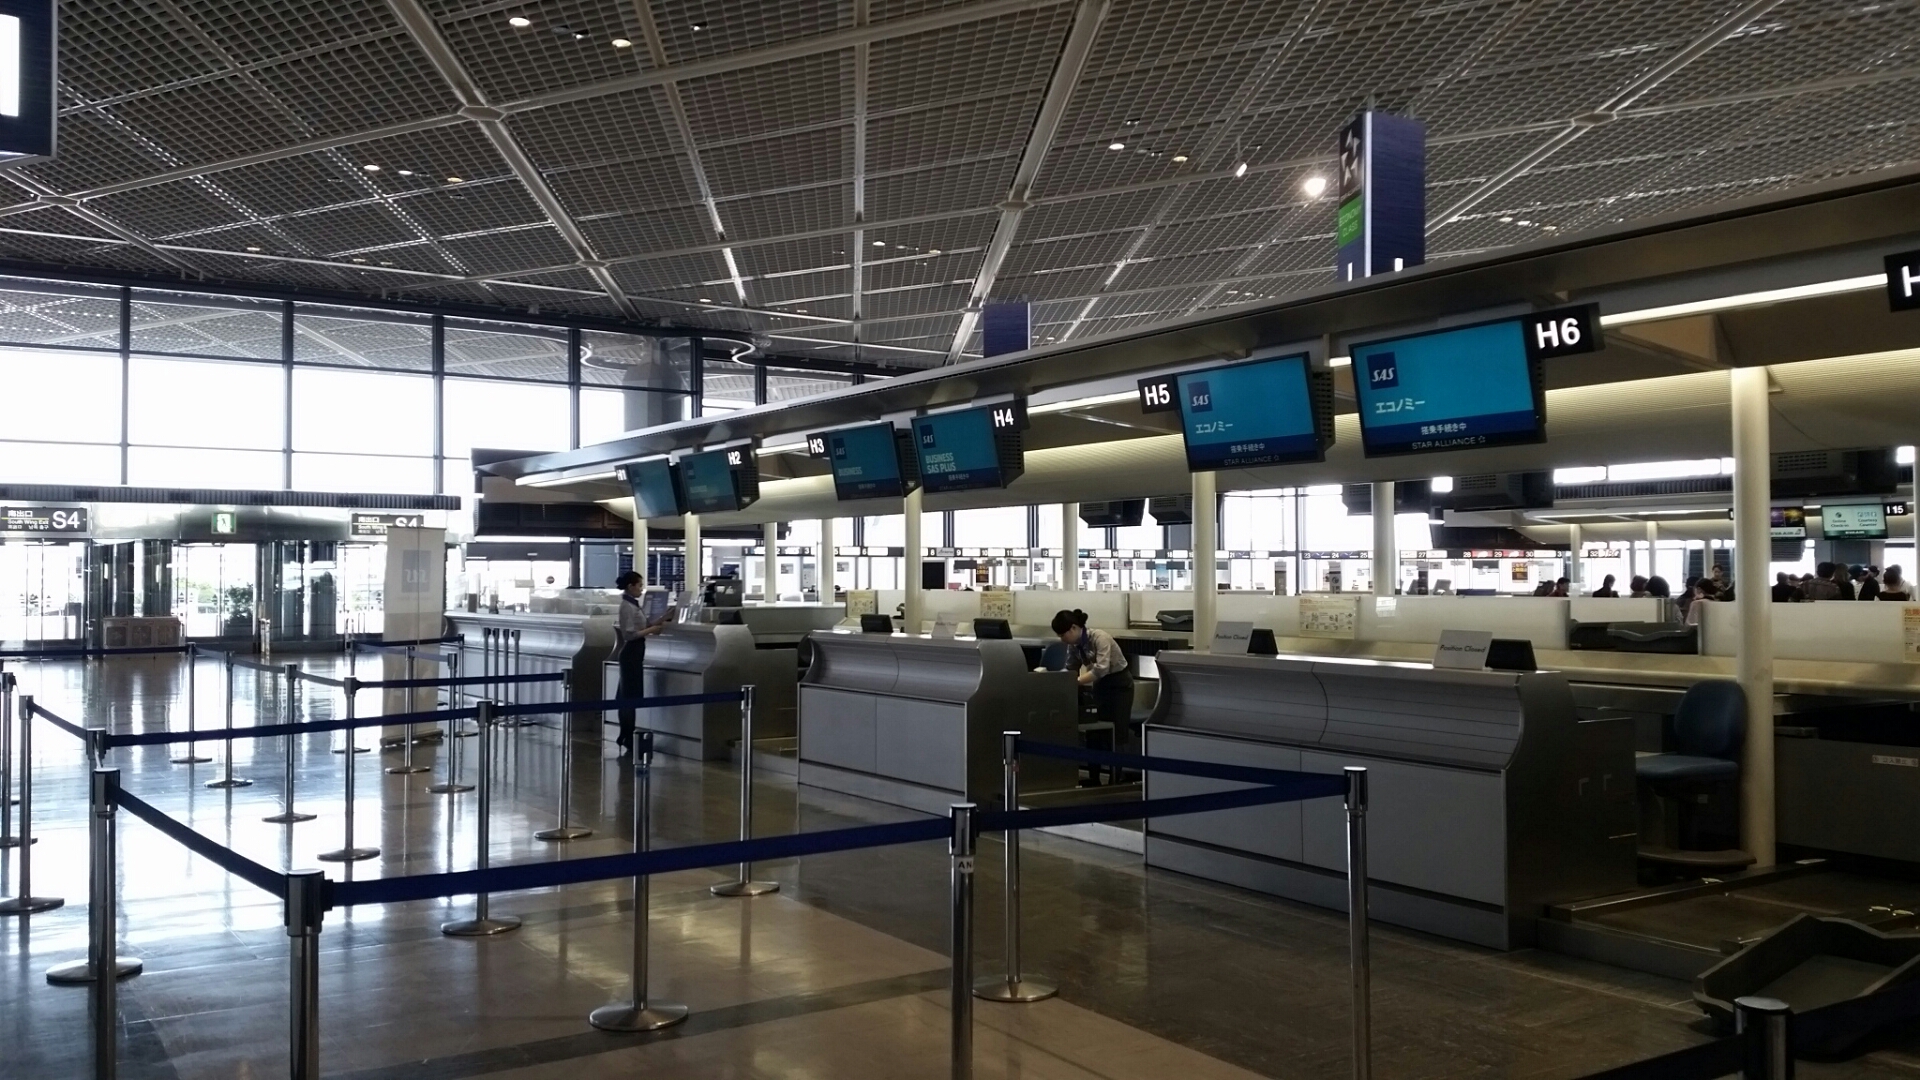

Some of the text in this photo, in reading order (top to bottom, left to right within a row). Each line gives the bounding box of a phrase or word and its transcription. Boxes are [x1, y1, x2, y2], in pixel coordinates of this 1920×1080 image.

[1342, 220, 1358, 237] CLASS
[1536, 318, 1581, 349] H6
[1372, 367, 1395, 382] SAS
[1144, 384, 1171, 406] H5
[1192, 394, 1209, 407] SAS
[1375, 398, 1425, 414] エコノミー
[994, 408, 1014, 428] H4
[1195, 421, 1233, 434] エコノミー
[809, 438, 825, 454] H3
[923, 434, 934, 444] SAS
[1412, 437, 1476, 450] STAR ALLIANCE
[728, 451, 742, 466] H2
[925, 452, 954, 463] BUSINESS
[1223, 455, 1272, 466] STAR ALLIANCE
[616, 469, 627, 481] H1
[927, 462, 956, 474] SAS PLUS
[52, 511, 80, 529] S4
